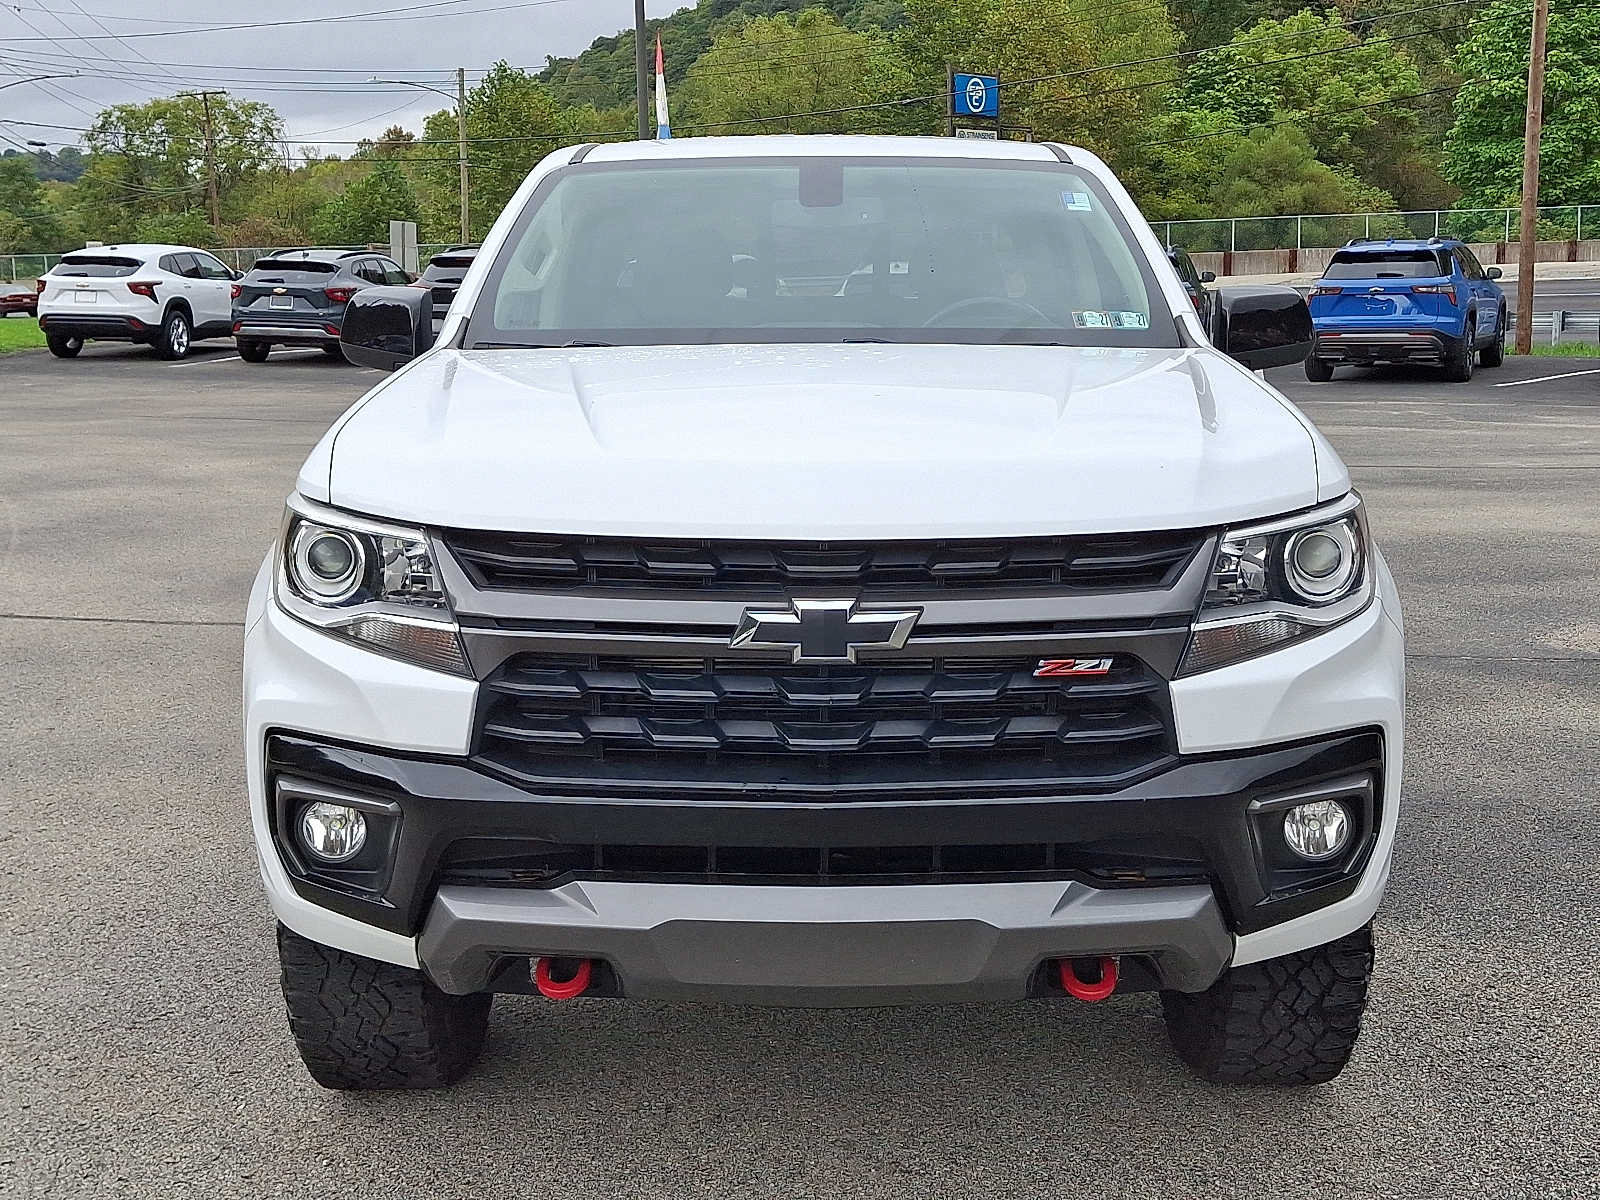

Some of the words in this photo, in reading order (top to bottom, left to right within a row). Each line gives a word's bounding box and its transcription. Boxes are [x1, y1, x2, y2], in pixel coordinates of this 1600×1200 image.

[1098, 313, 1109, 326] 27
[1136, 313, 1146, 326] 27
[1033, 658, 1114, 677] Z71
